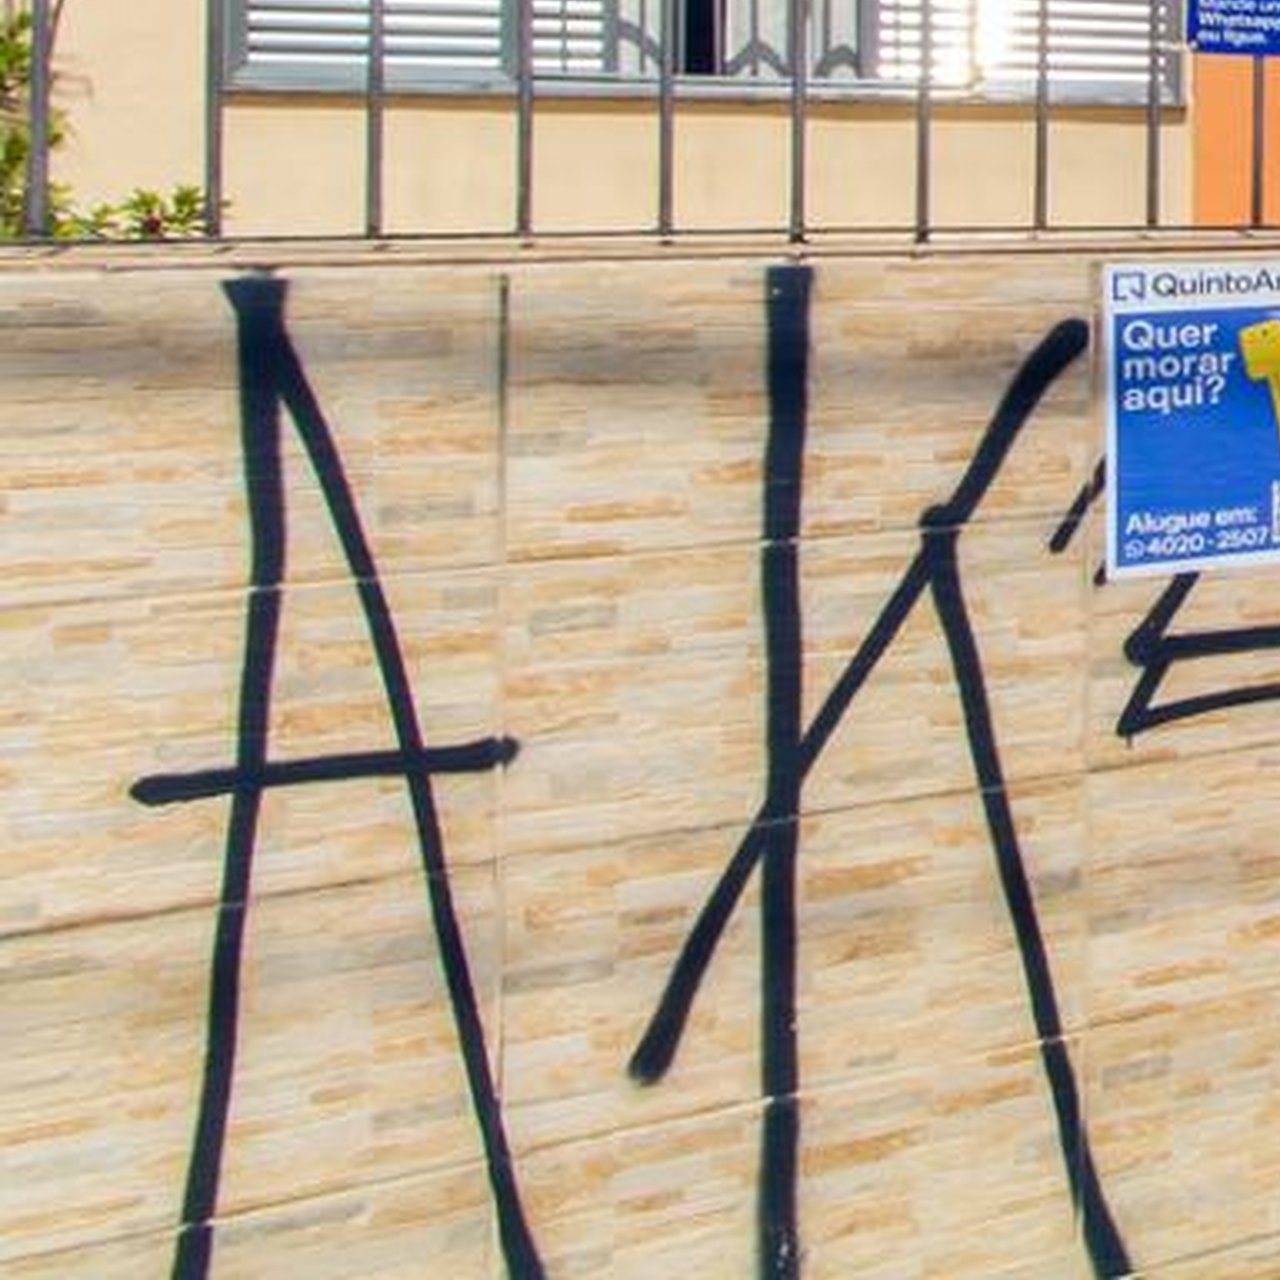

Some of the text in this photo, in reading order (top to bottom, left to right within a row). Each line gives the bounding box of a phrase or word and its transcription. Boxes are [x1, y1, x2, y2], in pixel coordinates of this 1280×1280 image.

[1121, 319, 1219, 350] Quer
[1121, 352, 1236, 380] morar
[1121, 376, 1227, 415] aqui?
[1124, 511, 1211, 535] Alugue
